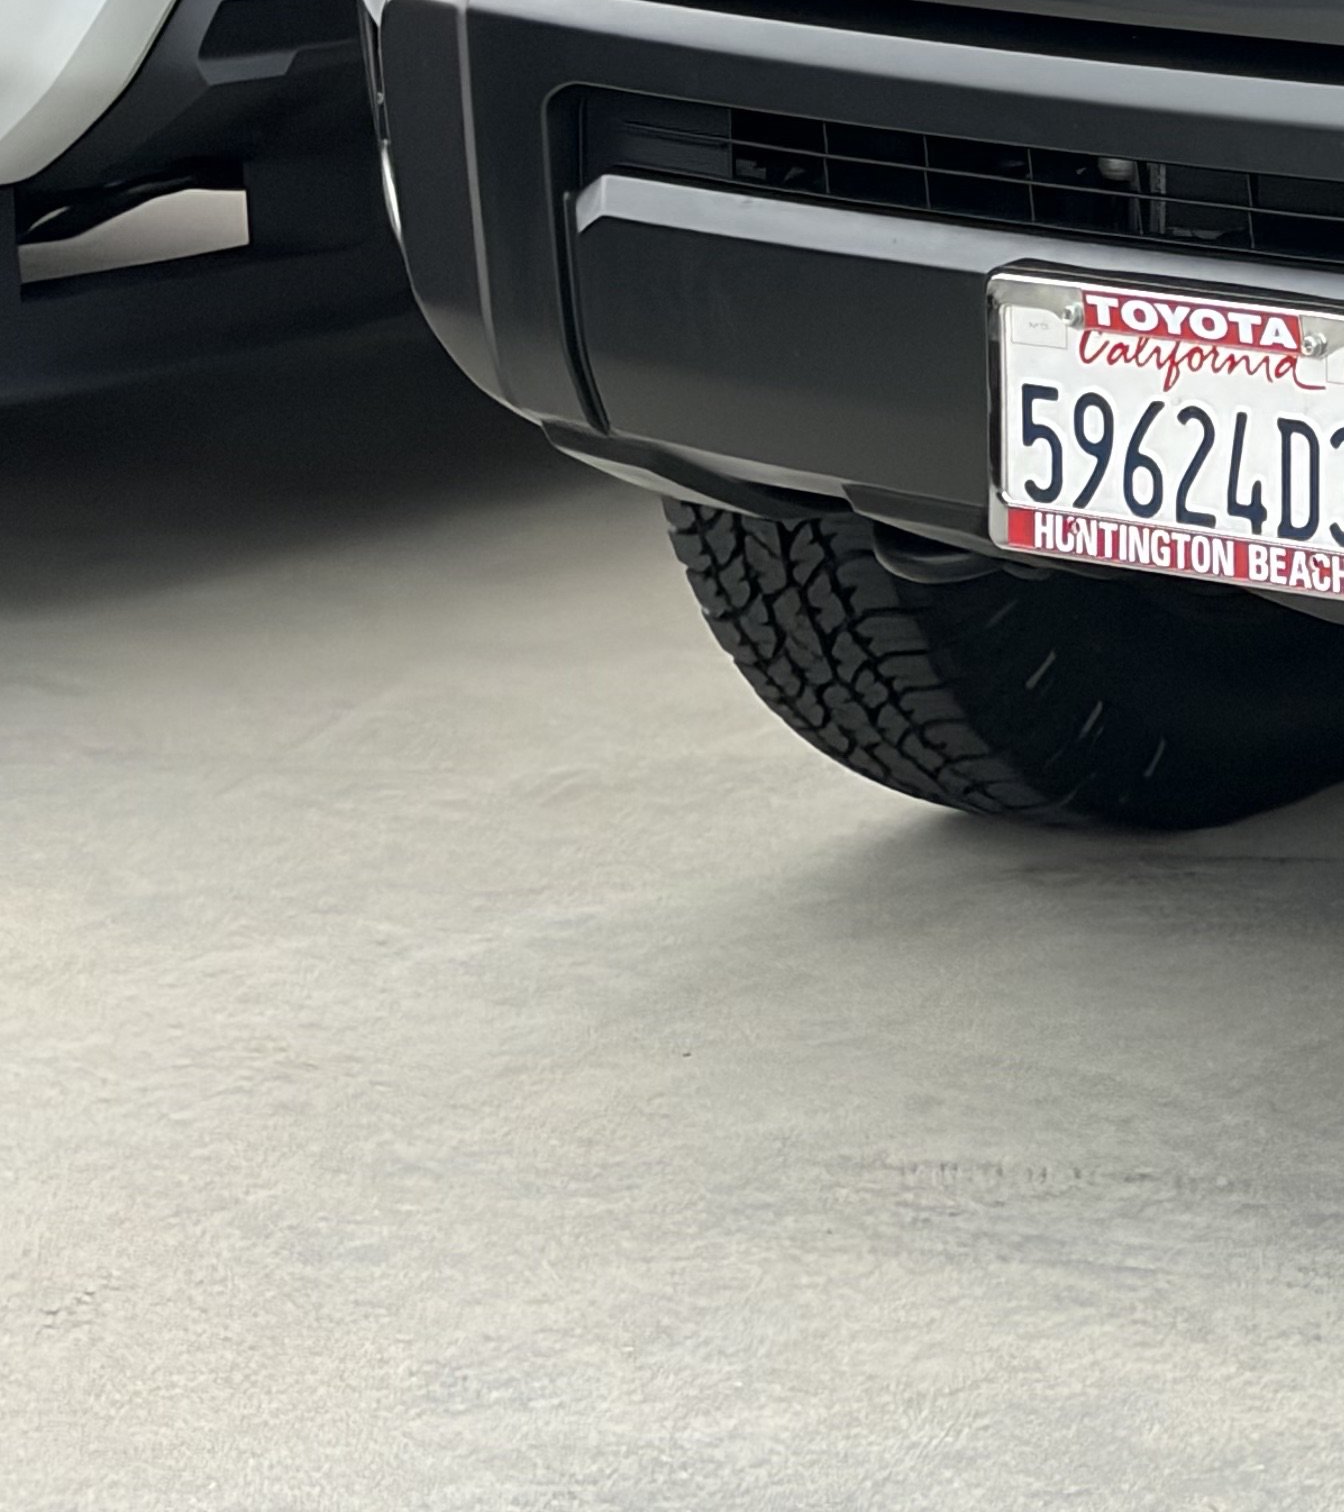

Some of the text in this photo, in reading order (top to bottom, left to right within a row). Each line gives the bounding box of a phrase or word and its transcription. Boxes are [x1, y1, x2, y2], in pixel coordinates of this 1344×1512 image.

[1085, 296, 1298, 350] TOYOTA
[1078, 331, 1326, 392] California
[1033, 511, 1236, 577] HUNTINGTON
